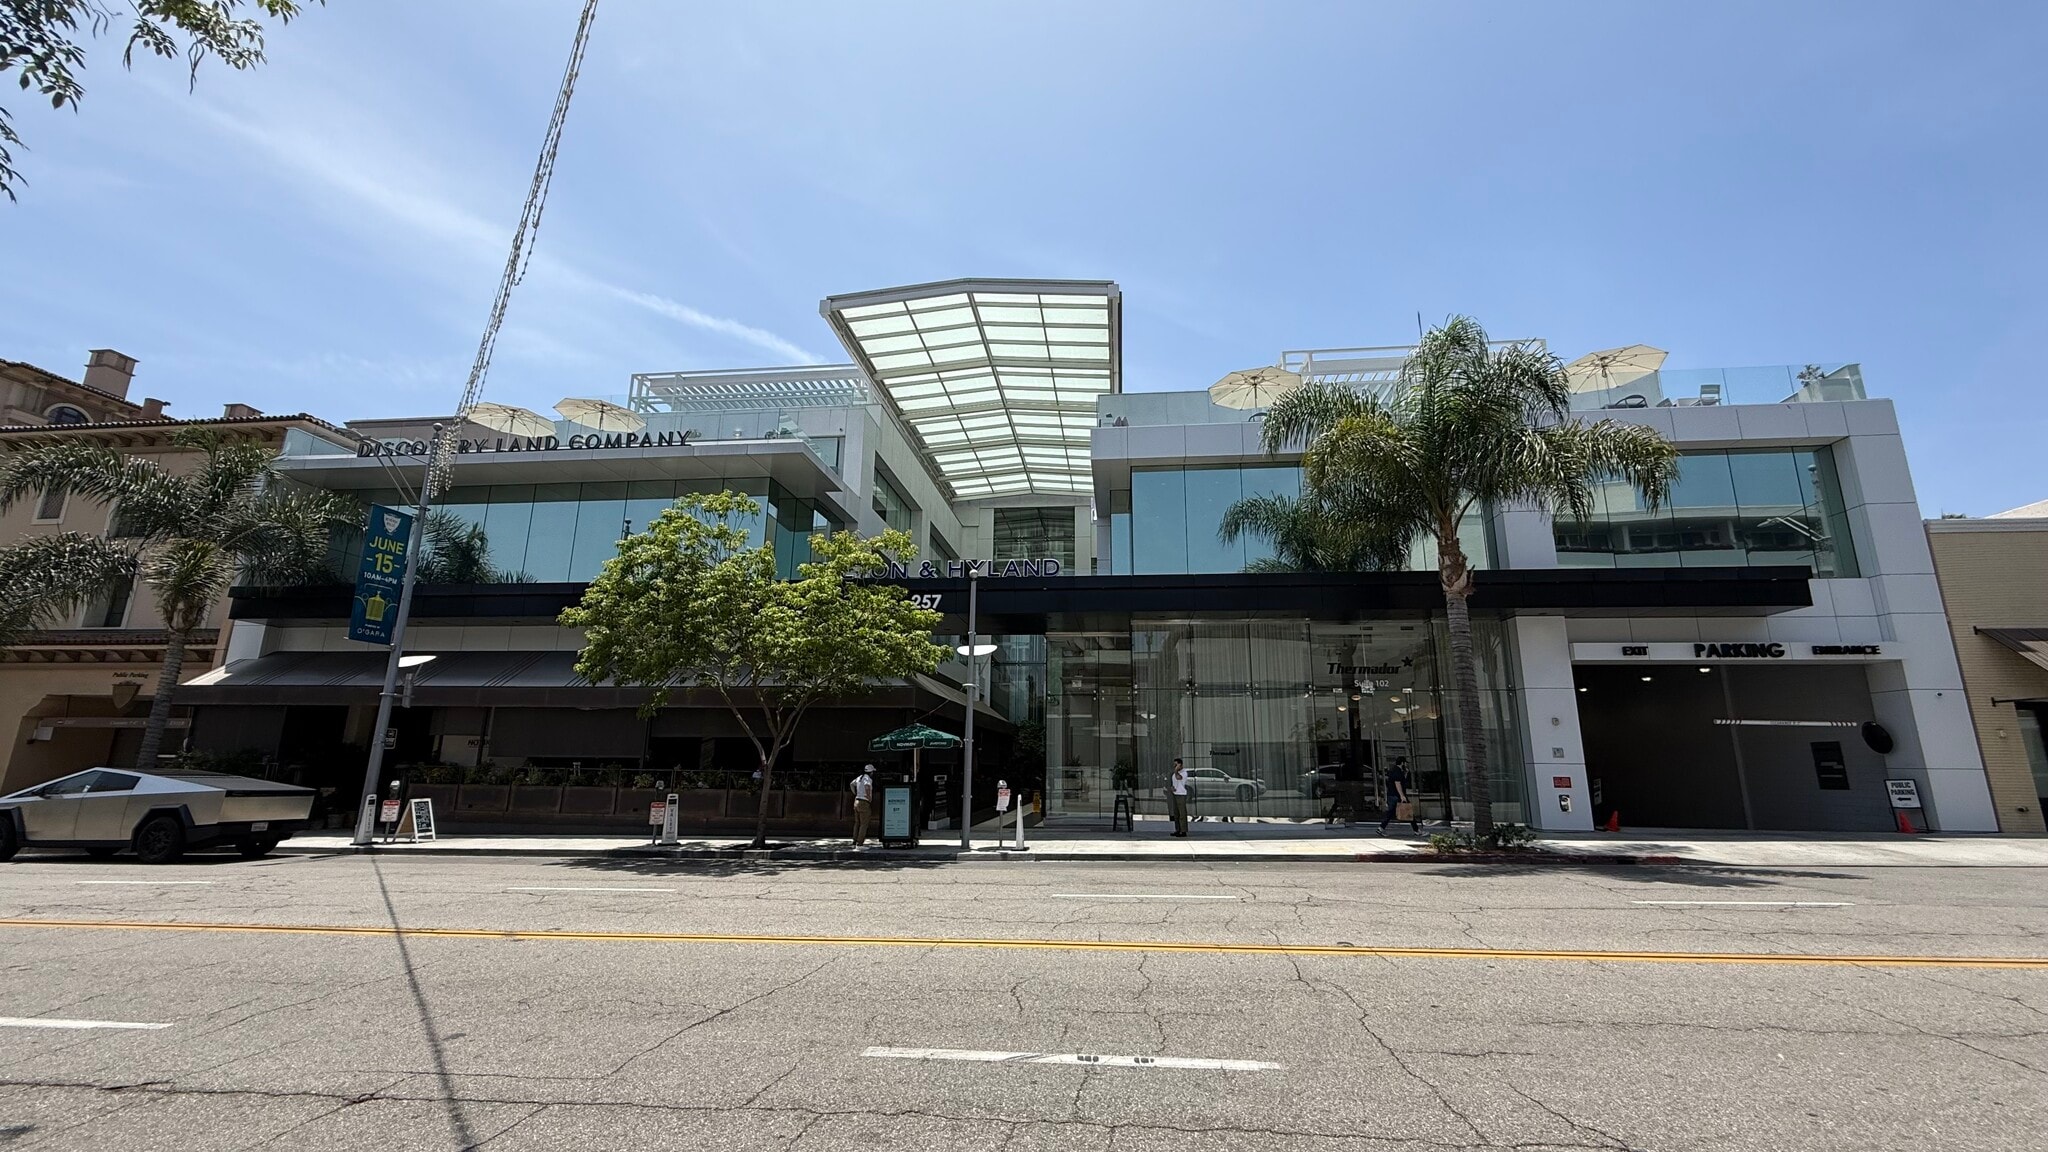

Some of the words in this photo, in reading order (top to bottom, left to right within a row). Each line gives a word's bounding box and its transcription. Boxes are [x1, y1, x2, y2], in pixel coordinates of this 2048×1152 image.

[357, 437, 489, 457] DISCORY
[496, 436, 560, 452] LAND
[569, 430, 691, 450] COMPANY
[369, 536, 405, 555] JUNE
[919, 560, 938, 579] &
[948, 558, 1060, 578] HYLAND
[911, 594, 943, 609] 257
[1622, 646, 1649, 656] EXIT
[1694, 643, 1785, 658] PARKING
[1327, 662, 1402, 674] Thermador
